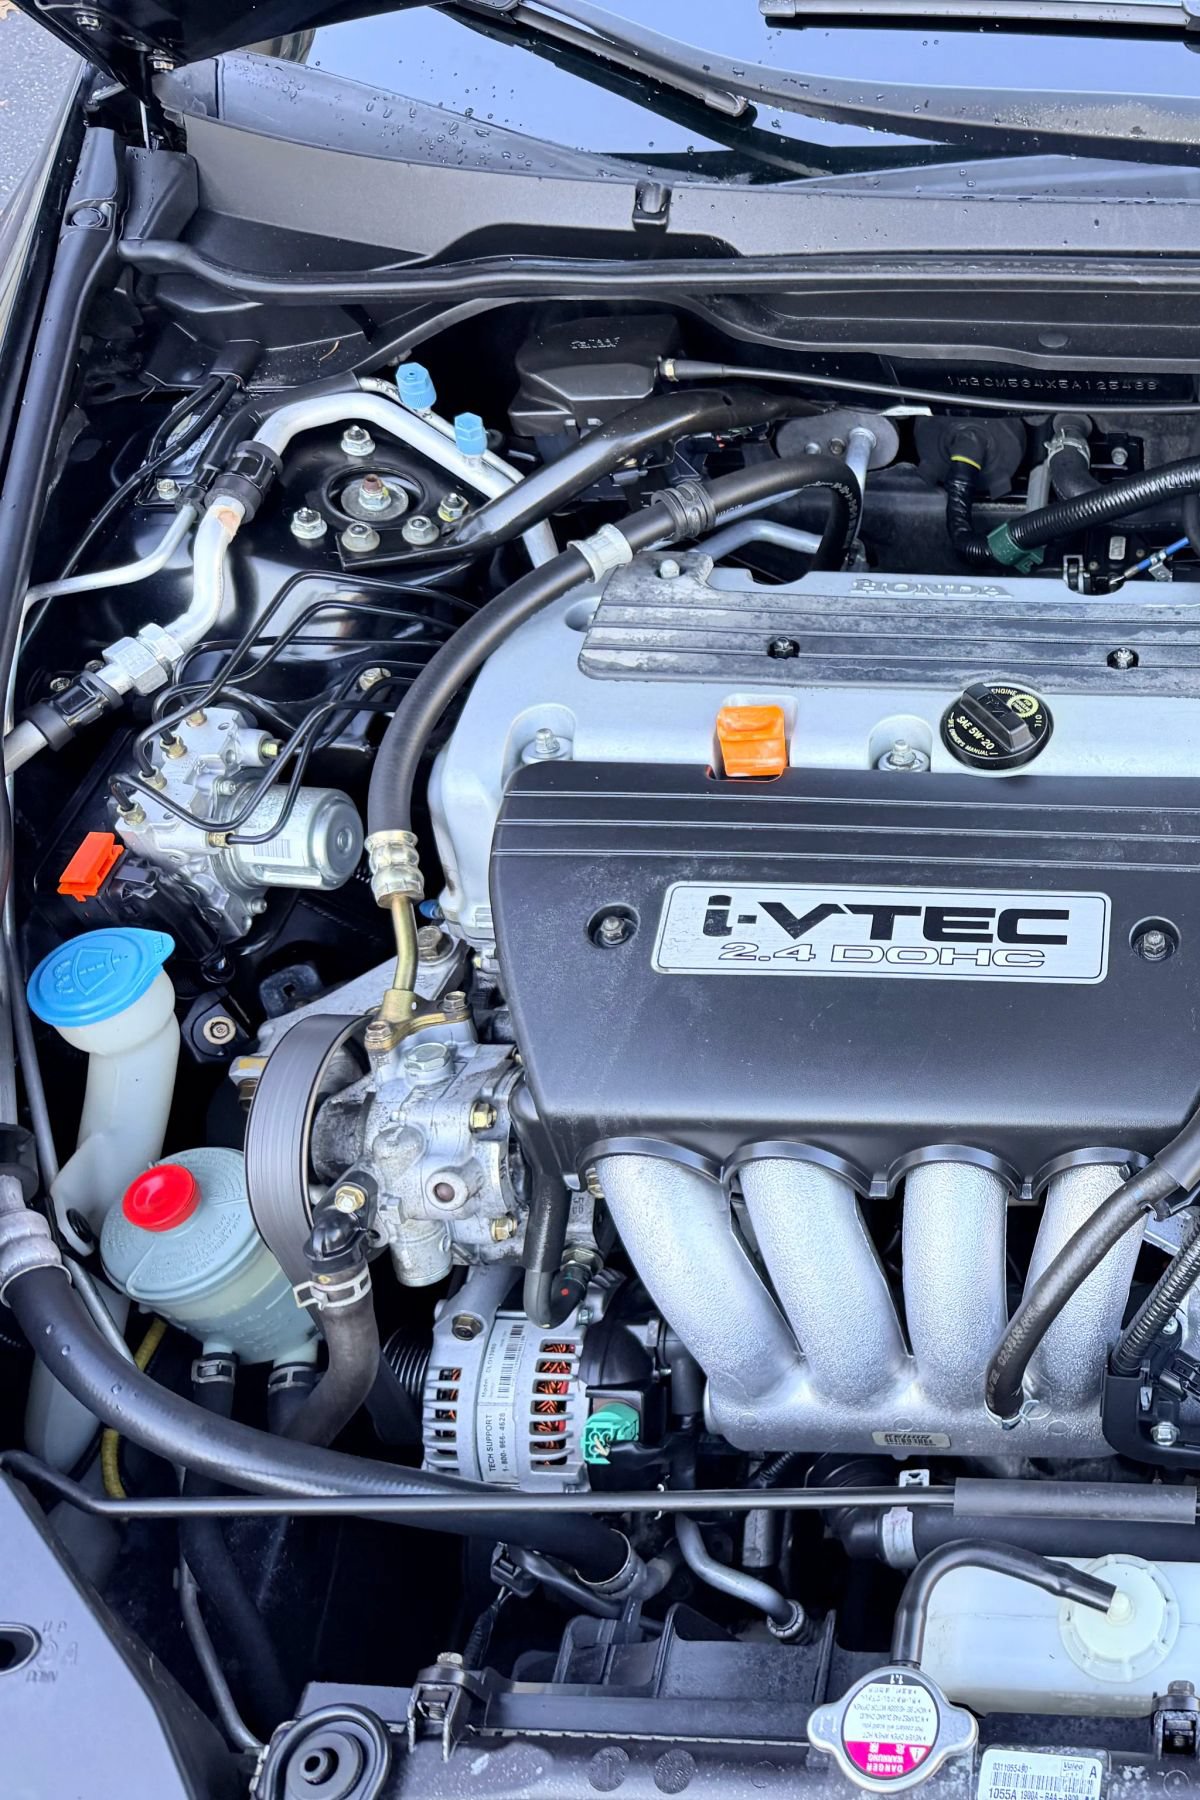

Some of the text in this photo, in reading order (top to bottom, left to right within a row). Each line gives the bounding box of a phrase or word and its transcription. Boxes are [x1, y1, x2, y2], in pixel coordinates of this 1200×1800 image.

[850, 578, 1014, 598] HONDA
[991, 688, 1018, 697] ENGINE
[1034, 714, 1043, 728] OIL
[956, 715, 995, 750] SAE 5W-20
[702, 894, 1070, 946] i-VTEC
[718, 942, 1047, 968] 2.4 DOHC
[485, 1413, 497, 1472] TECH SUPPORT
[889, 1674, 904, 1685] 1.1
[866, 1763, 903, 1773] DANGER
[1088, 1765, 1098, 1779] A
[989, 1788, 1017, 1800] 1055A
